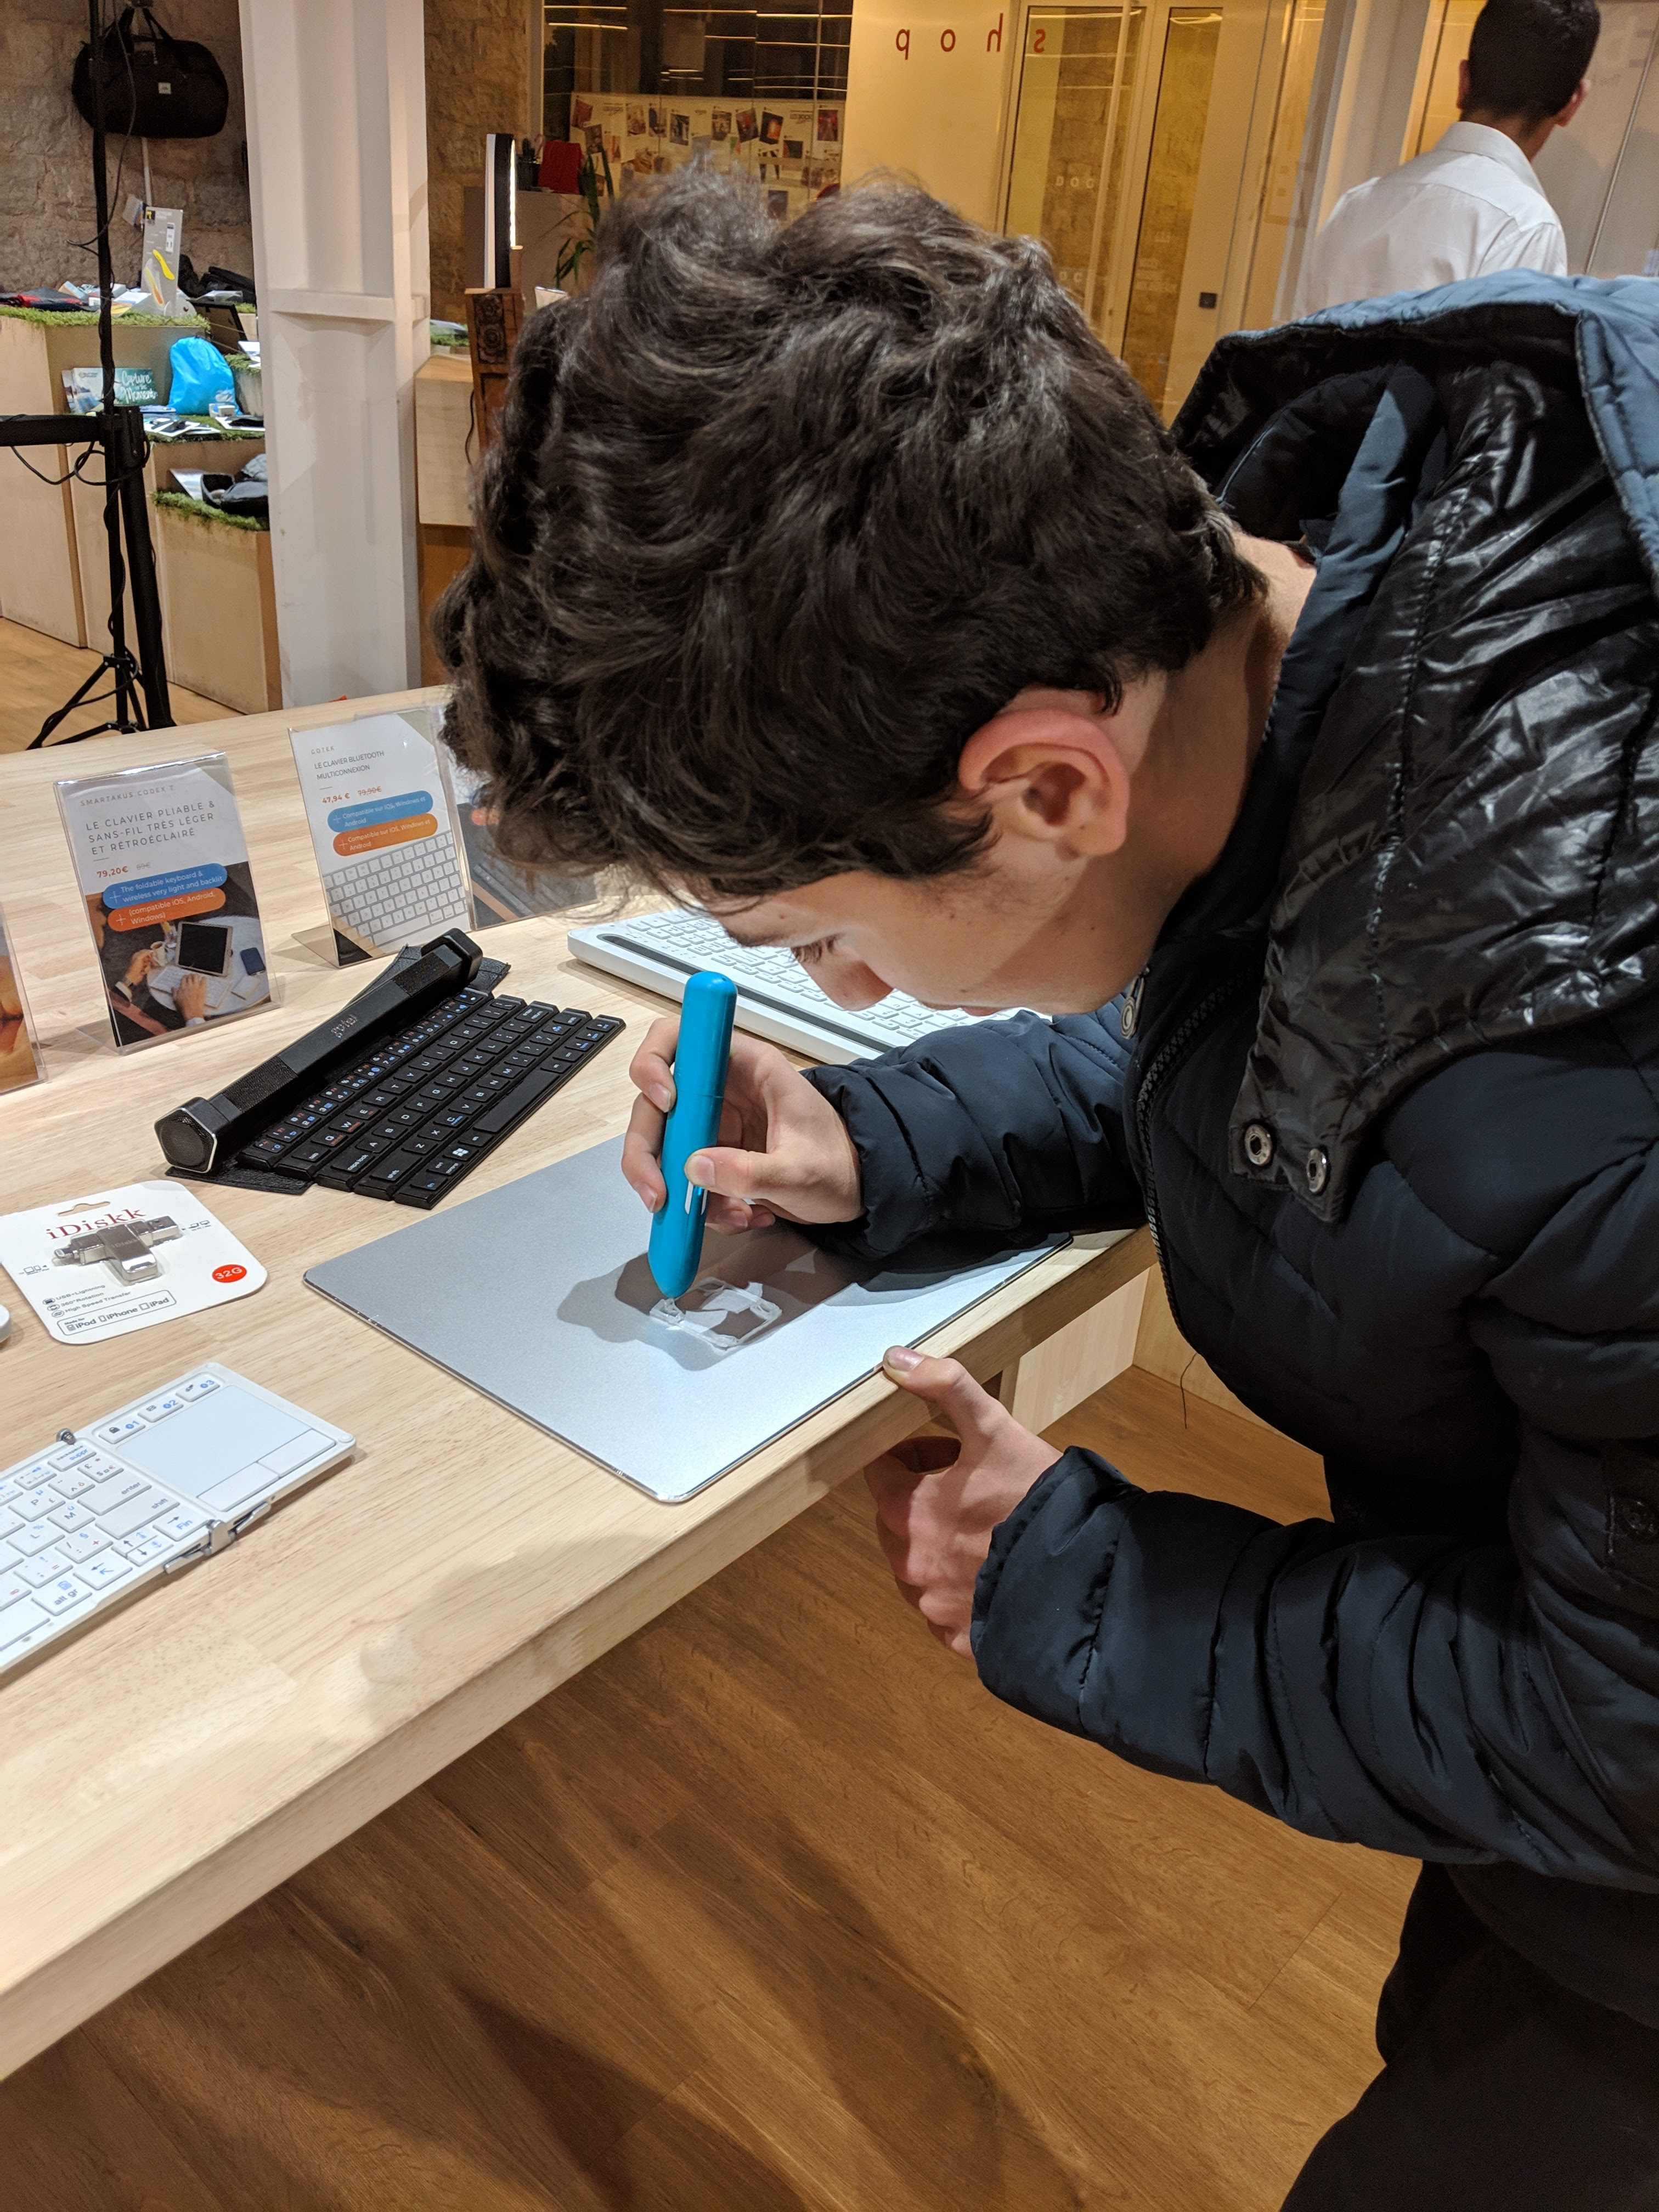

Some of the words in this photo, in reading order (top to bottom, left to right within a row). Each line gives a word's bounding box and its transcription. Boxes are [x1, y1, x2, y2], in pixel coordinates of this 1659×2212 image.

[311, 746, 335, 754] GOTEK
[323, 757, 348, 768] CLAVIER
[348, 751, 385, 763] BLUETOOTH
[317, 764, 370, 780] MULTICONNEXION
[80, 792, 134, 806] SMARTAKUS
[137, 786, 166, 797] CODEX
[322, 793, 342, 804] 47,94
[86, 821, 99, 831] LE
[105, 811, 154, 827] CLAVIER
[157, 802, 204, 817] PLIABLE
[342, 808, 374, 819] Compatible
[396, 799, 420, 808] Windows
[88, 826, 143, 843] SANS-FIL
[147, 820, 174, 832] TRÈS
[179, 812, 215, 826] LÉGER
[345, 818, 366, 827] Android
[348, 831, 380, 843] Compatible
[400, 821, 424, 830] Windows
[92, 845, 105, 855] ET
[111, 828, 195, 851] RÉTROÉCLAIRÉ
[349, 842, 371, 851] Android
[97, 866, 128, 878] 79,20€
[122, 891, 151, 902] wireless
[153, 888, 167, 898] very
[168, 883, 184, 894] light
[186, 879, 199, 888] and
[200, 874, 223, 885] backlit
[136, 879, 163, 890] foldable
[165, 872, 196, 884] keyboard
[129, 900, 171, 917] (compatible
[130, 911, 166, 925] Windows)
[46, 1209, 146, 1240] iDiskk
[215, 1266, 243, 1280] 32G
[82, 1299, 103, 1308] Speed
[104, 1291, 131, 1302] Transfer
[76, 1318, 97, 1329] iPod
[106, 1307, 138, 1320] iPhone
[149, 1297, 170, 1308] iPad
[121, 1482, 140, 1494] enter
[151, 1498, 168, 1509] shift
[176, 1520, 193, 1530] Fin
[54, 1595, 68, 1606] alt
[68, 1588, 79, 1600] gr
